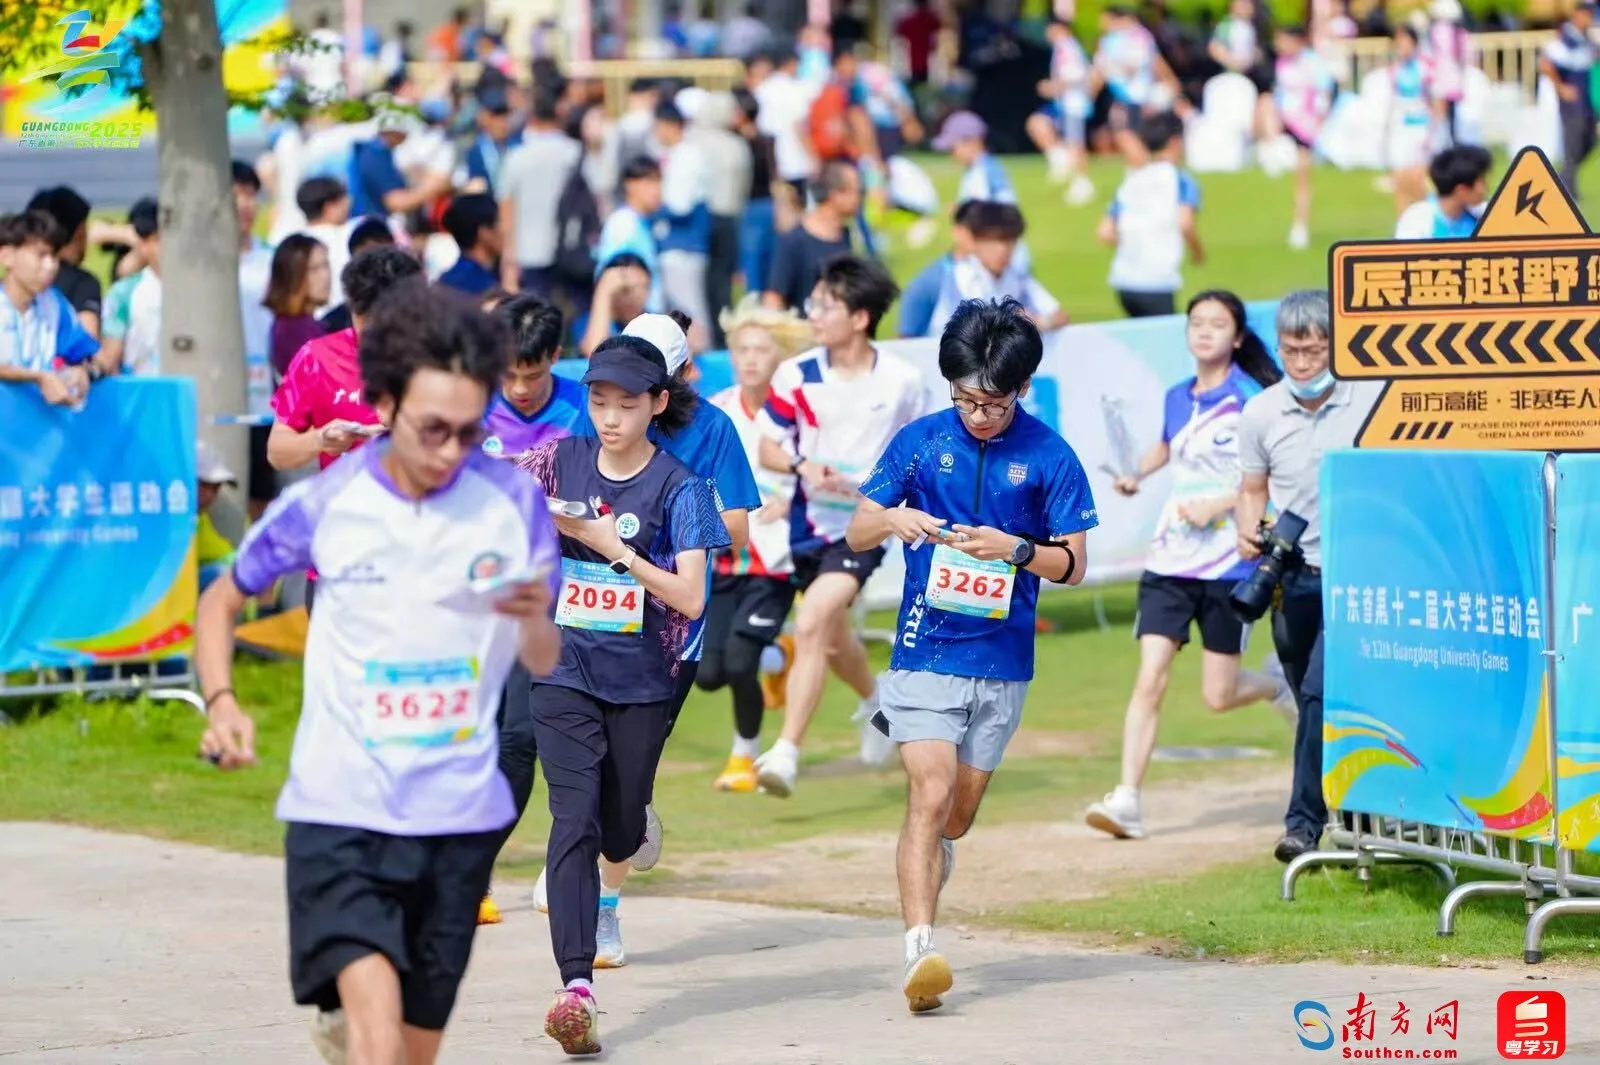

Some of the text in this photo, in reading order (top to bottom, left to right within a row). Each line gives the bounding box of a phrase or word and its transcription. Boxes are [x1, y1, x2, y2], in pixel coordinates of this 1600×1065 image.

[1401, 387, 1600, 412] 前方高能·非赛车人
[1460, 420, 1498, 429] PLEASE
[1543, 419, 1600, 427] APPROACH
[567, 583, 637, 611] 2094
[936, 567, 1006, 599] 3262
[903, 593, 924, 648] SZTU
[1331, 583, 1541, 640] 广东省第十二届大学生运动会
[1572, 602, 1594, 645] 广
[1372, 640, 1392, 660] 12th
[1393, 641, 1439, 669] Guangdong
[1441, 645, 1480, 673] University
[1482, 650, 1509, 672] Games
